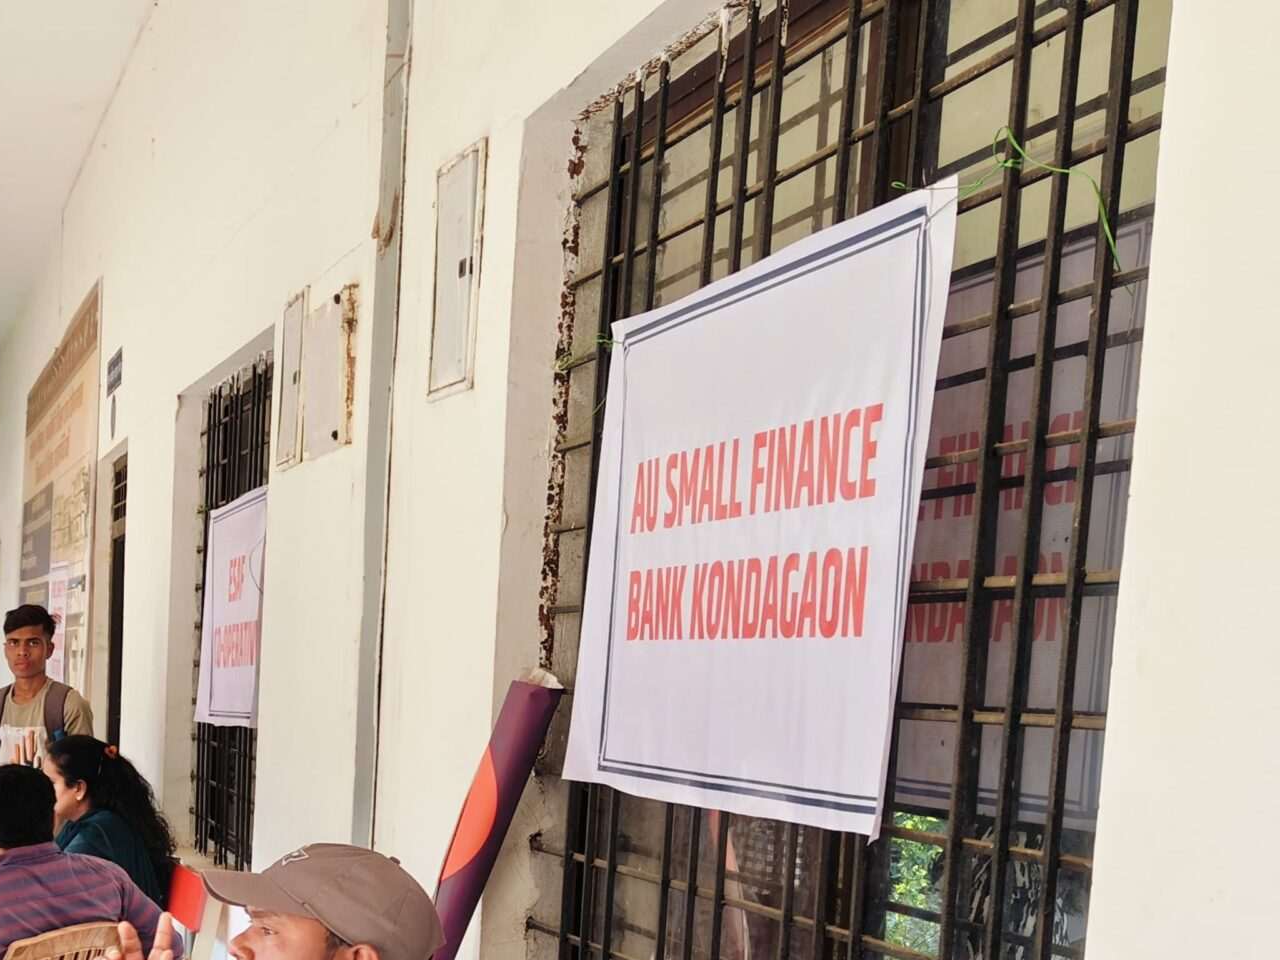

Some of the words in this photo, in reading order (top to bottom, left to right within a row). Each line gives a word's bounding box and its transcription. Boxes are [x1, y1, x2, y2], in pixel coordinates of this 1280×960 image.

[630, 457, 660, 534] AU
[663, 437, 742, 529] SMALL
[749, 402, 884, 515] FINANCE
[626, 565, 687, 641] BANK
[689, 545, 869, 640] KONDAGAON
